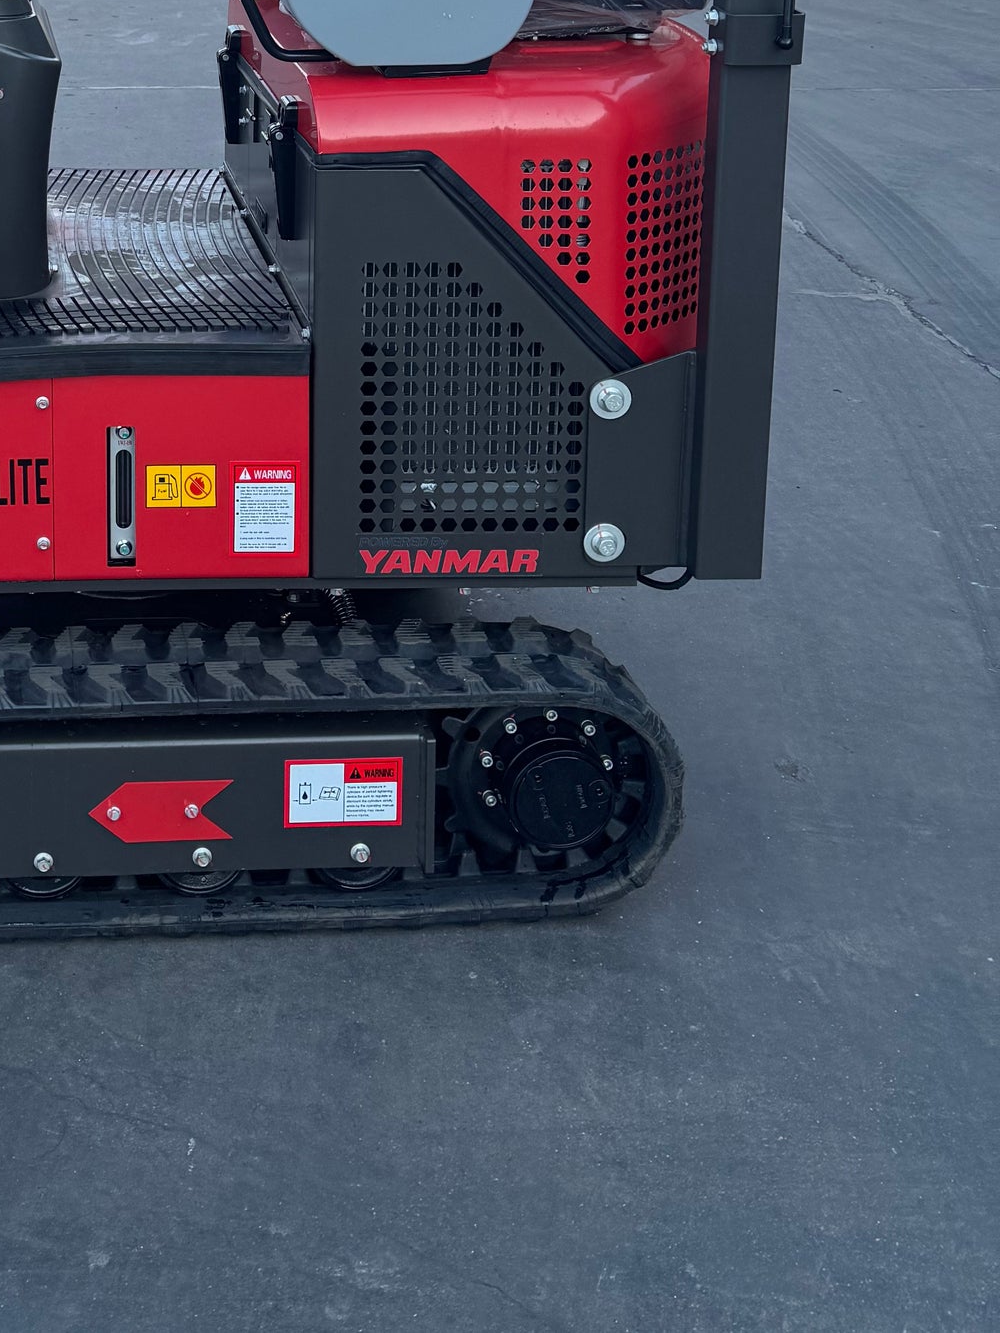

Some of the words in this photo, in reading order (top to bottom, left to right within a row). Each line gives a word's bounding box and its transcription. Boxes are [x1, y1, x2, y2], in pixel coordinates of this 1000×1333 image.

[253, 469, 292, 480] WARNING
[358, 549, 541, 574] YANMAR
[364, 768, 394, 778] WARNING
